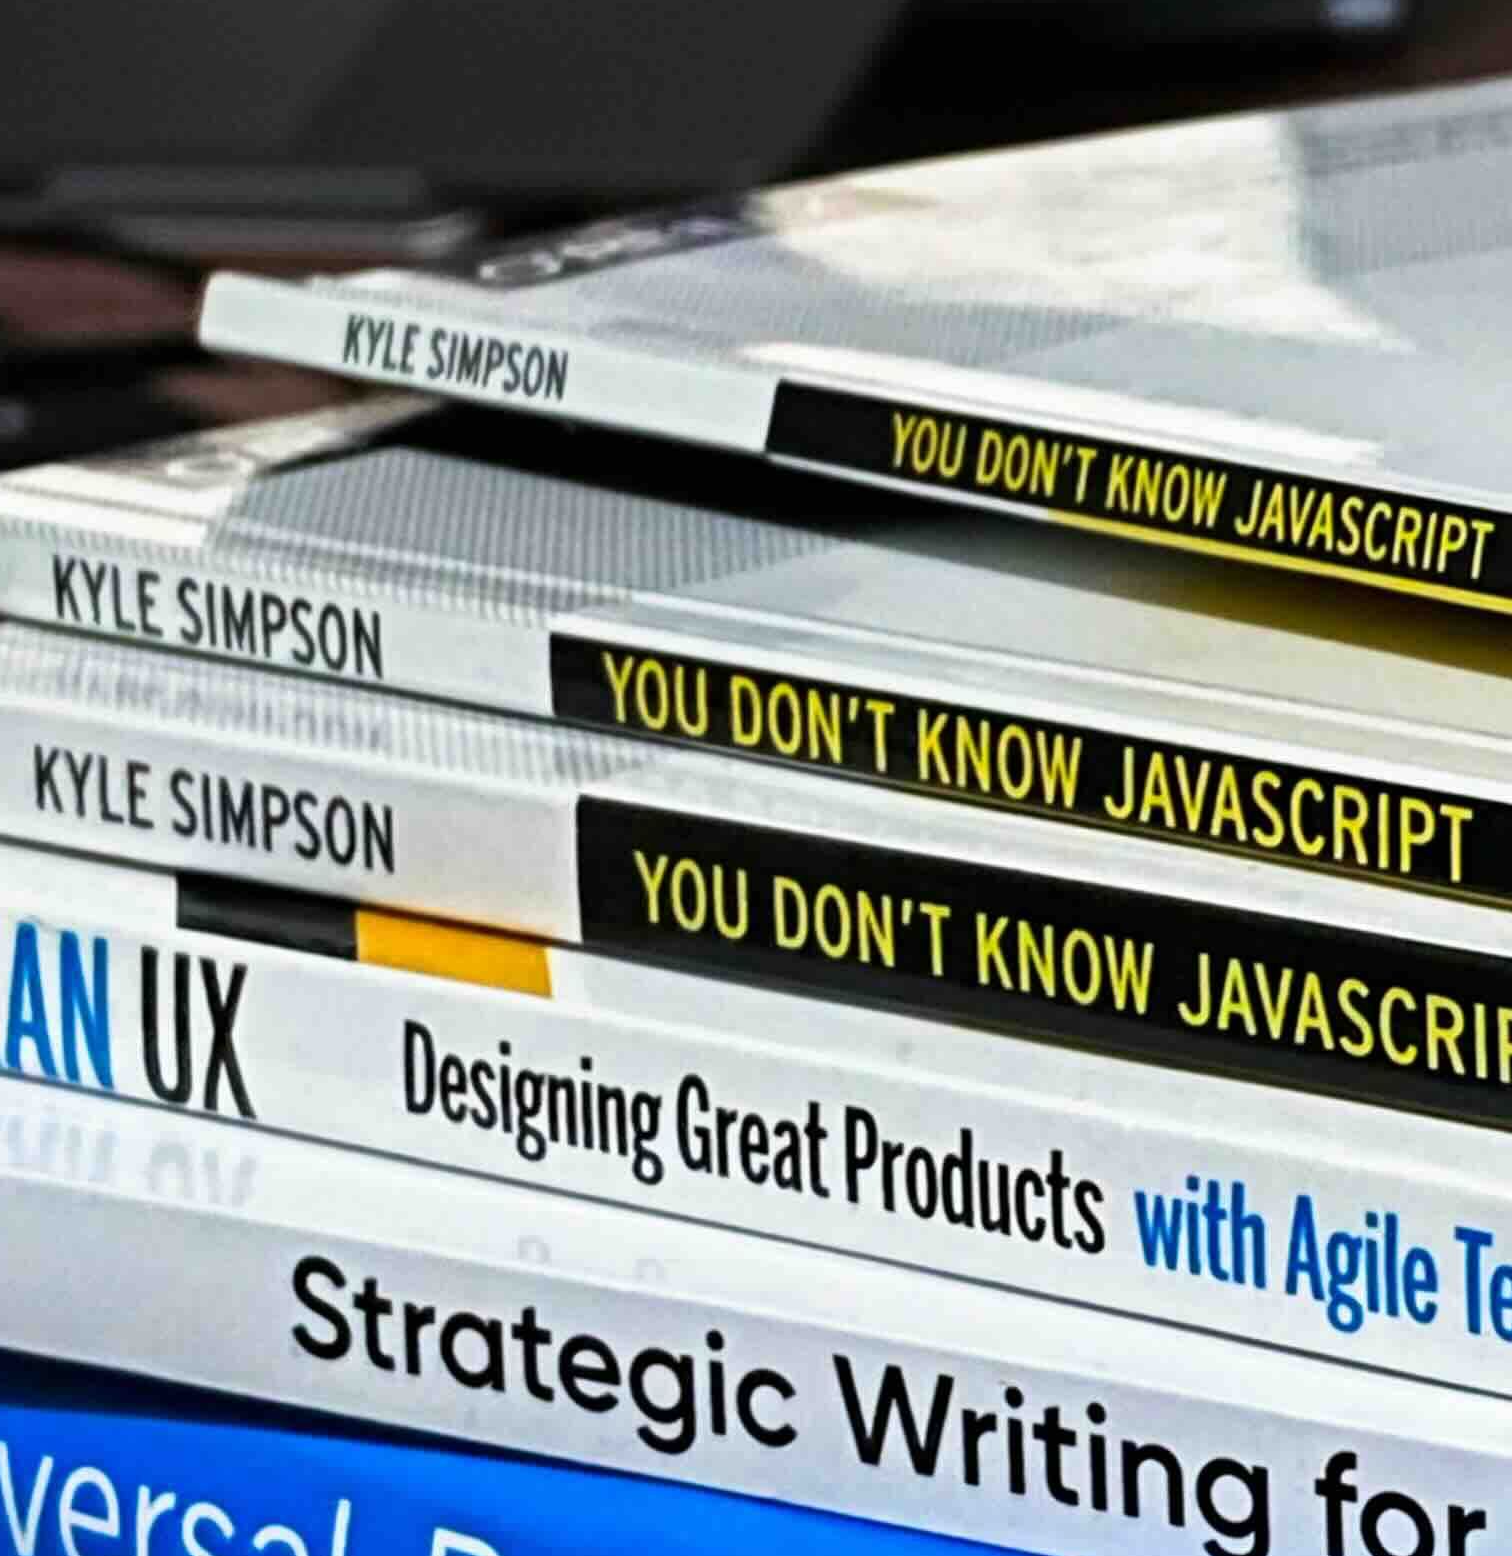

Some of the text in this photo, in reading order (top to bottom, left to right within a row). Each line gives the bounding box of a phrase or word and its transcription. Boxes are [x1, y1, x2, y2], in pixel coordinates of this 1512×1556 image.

[343, 313, 568, 402] KYLE SIMPSON
[891, 415, 964, 479] YOU
[977, 430, 1097, 502] DON'T
[1106, 457, 1227, 527] KNOW
[1233, 481, 1494, 579] JAVASCRIPT
[53, 554, 383, 679] KYLE SIMPSON
[34, 745, 395, 874] KYLE SIMPSON
[602, 652, 709, 737] YOU
[730, 677, 894, 770] DON'T
[917, 710, 1084, 809] KNOW
[1104, 746, 1473, 882] JAVASCRIPT
[633, 851, 749, 940] YOU
[772, 880, 951, 978] DON'T
[975, 917, 1154, 1013] KNOW
[139, 945, 257, 1119] UX
[402, 1019, 663, 1185] Designing
[675, 1076, 830, 1198] Great
[844, 1103, 1105, 1253] Products
[1134, 1173, 1266, 1290] with
[1284, 1192, 1437, 1333] Agile
[289, 1254, 797, 1453] Strategic
